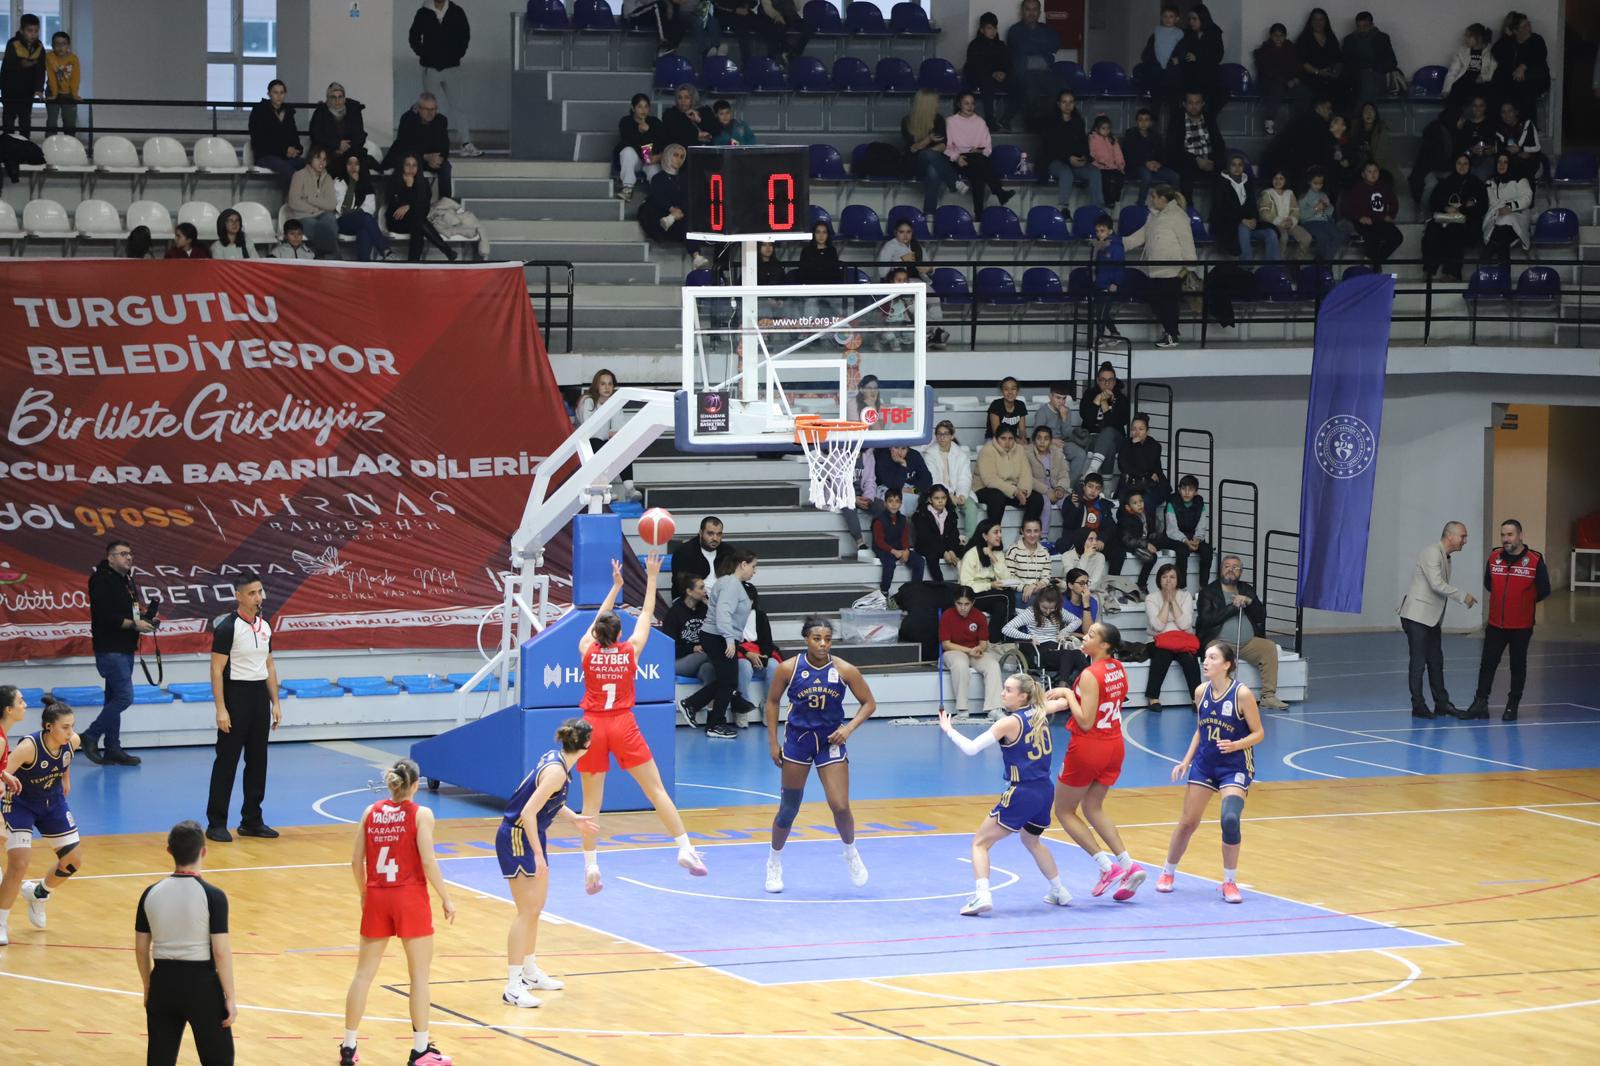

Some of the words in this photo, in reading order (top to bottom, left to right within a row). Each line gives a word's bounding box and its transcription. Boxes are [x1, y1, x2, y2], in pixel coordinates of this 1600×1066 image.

[768, 173, 794, 230] 0
[13, 292, 279, 329] TURGUTLU
[27, 335, 400, 376] BELEDİYESPOR
[8, 387, 182, 446] Birlikte
[183, 382, 386, 447] Güçlüyüz
[880, 407, 912, 425] TBF
[183, 453, 402, 485] BAŞARILAR
[74, 506, 195, 536] gross
[93, 563, 295, 578] ARAATA
[141, 583, 267, 604] BETO
[590, 653, 630, 665] ZEYBEK
[590, 665, 629, 673] KARAATA
[602, 683, 617, 710] 1
[808, 694, 826, 710] 31
[1096, 699, 1122, 729] 24
[1025, 725, 1053, 760] 30
[1207, 725, 1221, 742] 14
[367, 826, 406, 834] KARAATA
[376, 846, 399, 882] 4
